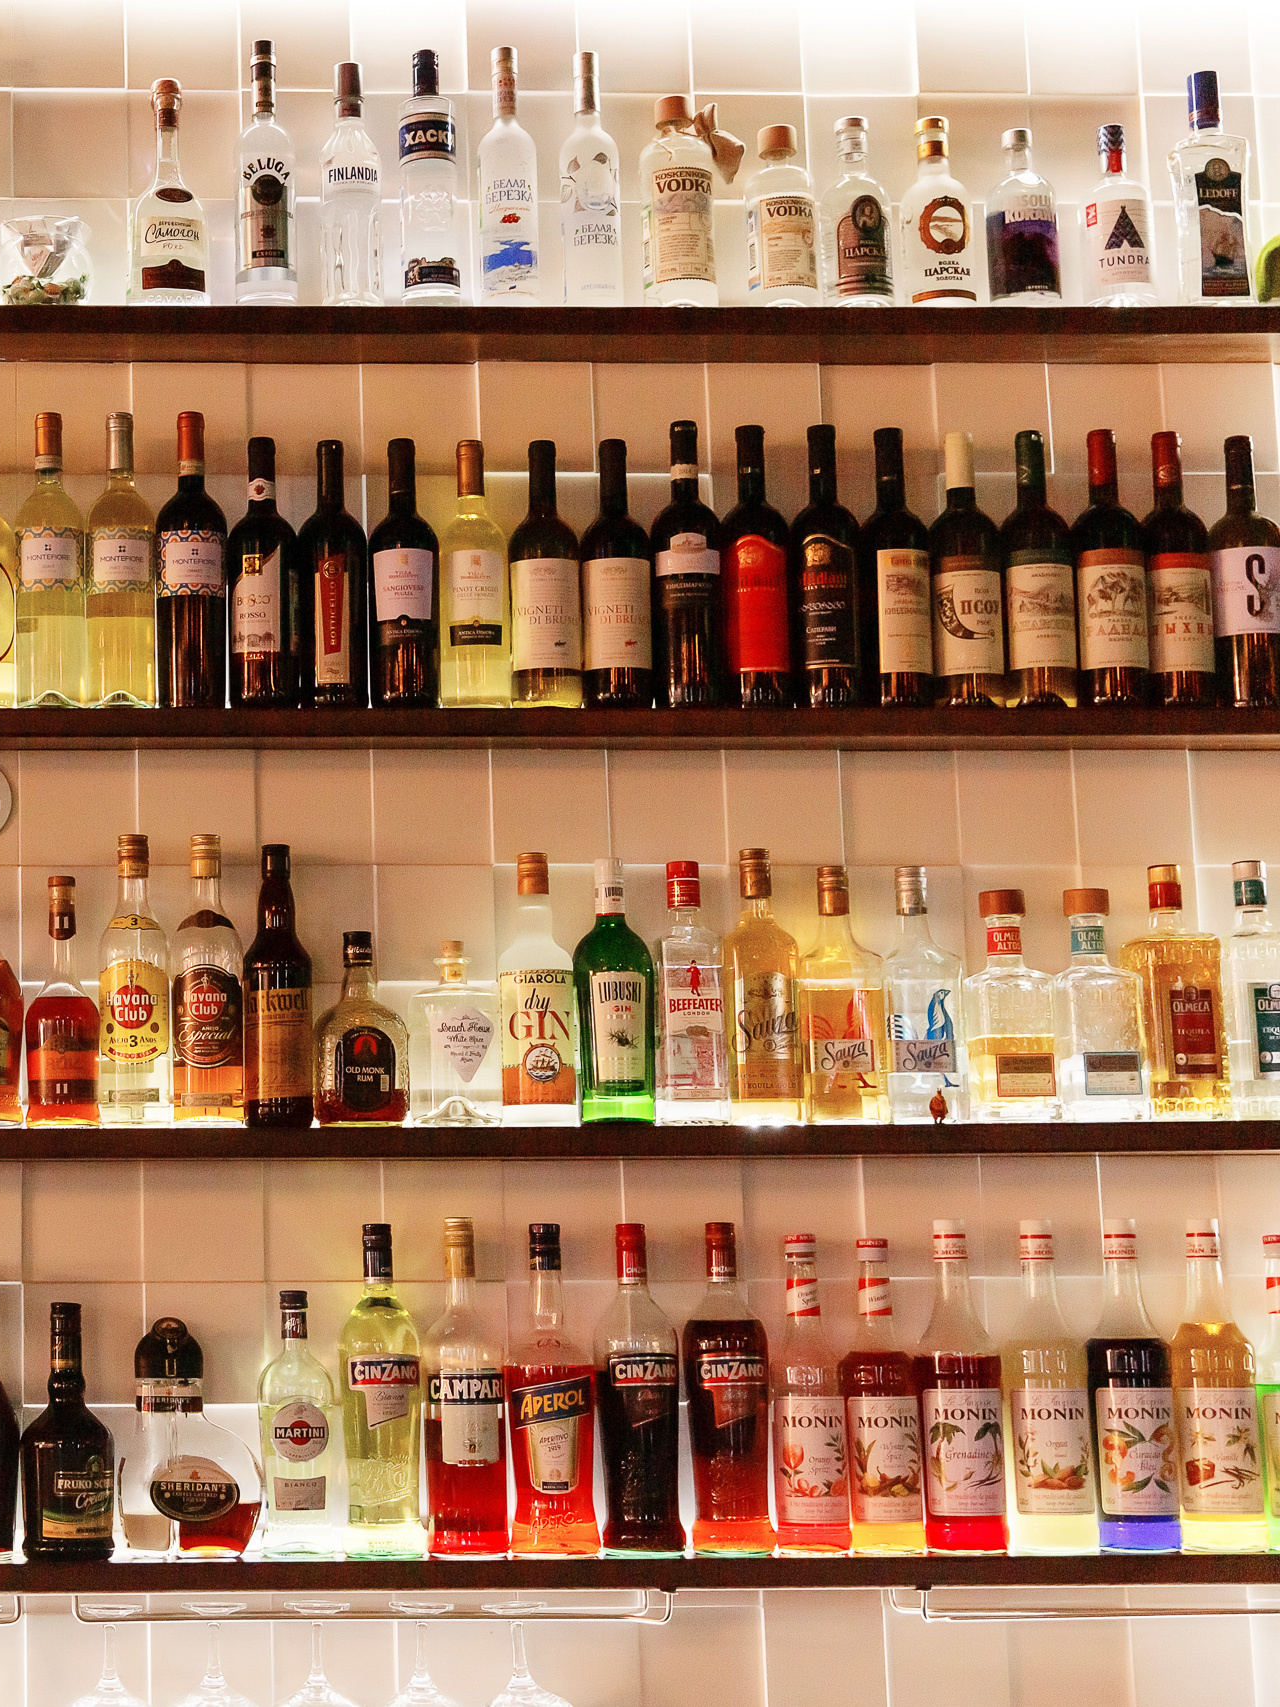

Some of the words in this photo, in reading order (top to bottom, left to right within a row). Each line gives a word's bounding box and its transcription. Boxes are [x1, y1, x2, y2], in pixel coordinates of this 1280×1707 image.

[242, 157, 291, 182] BELUGA
[328, 166, 378, 184] FINLANDIA
[493, 179, 526, 190] БЕЛАЯ
[656, 178, 713, 195] VODKA
[485, 188, 534, 205] БЕРЕЗКА
[767, 205, 814, 219] VODKA
[581, 224, 612, 234] БЕЛАЯ
[574, 233, 619, 247] БЕРЕЗКА
[1099, 254, 1150, 269] TUNDRA
[924, 266, 971, 278] ЦАРСКАЯ
[26, 553, 71, 562] MONTEFIORE
[99, 555, 144, 563] MONTEFIORE
[172, 558, 217, 566] MONTEFIORE
[239, 611, 266, 620] ROSSO
[517, 605, 563, 617] VIGNETI
[529, 616, 541, 625] DI
[600, 615, 611, 625] DI
[130, 917, 139, 926] 3
[513, 973, 567, 985] GIAROLA
[106, 991, 158, 1006] Havana
[183, 990, 228, 1005] Havana
[598, 980, 642, 1004] LUBUSKI
[191, 1003, 219, 1016] Club
[524, 988, 552, 1019] dry
[612, 1004, 632, 1013] GIN
[669, 998, 723, 1014] BEEFEATER
[1172, 1000, 1211, 1013] OLMECA
[115, 1007, 148, 1022] Club
[178, 1021, 236, 1043] Especial
[437, 1022, 467, 1034] Beach
[509, 1010, 571, 1041] GIN
[731, 1009, 799, 1053] Sauza
[1177, 1028, 1211, 1036] TEQUILA
[129, 1035, 138, 1048] 3
[447, 1032, 468, 1043] White
[821, 1041, 868, 1071] Sauza
[902, 1041, 950, 1071] Sauza
[345, 1066, 361, 1075] OLD
[361, 1066, 385, 1076] MONK
[356, 1075, 375, 1083] RUM
[353, 1363, 418, 1382] CINZANO
[614, 1362, 677, 1380] CINZANO
[700, 1361, 764, 1380] CINZANO
[373, 1390, 405, 1402] Bianco
[430, 1379, 504, 1400] CAMPARI
[520, 1389, 585, 1421] APEROL
[933, 1407, 998, 1421] MONIN
[1020, 1407, 1084, 1420] MONIN
[1106, 1406, 1171, 1420] MONIN
[1185, 1406, 1251, 1421] MONIN
[782, 1415, 843, 1429] MONIN
[857, 1415, 918, 1429] MONIN
[275, 1426, 325, 1439] MARTINI
[539, 1433, 569, 1445] APERITIVO
[547, 1444, 562, 1453] 1919
[944, 1449, 991, 1464] Grenadine
[57, 1479, 93, 1490] FRUKO
[160, 1481, 228, 1493] SHERIDAN'S
[284, 1481, 318, 1489] BIANCO
